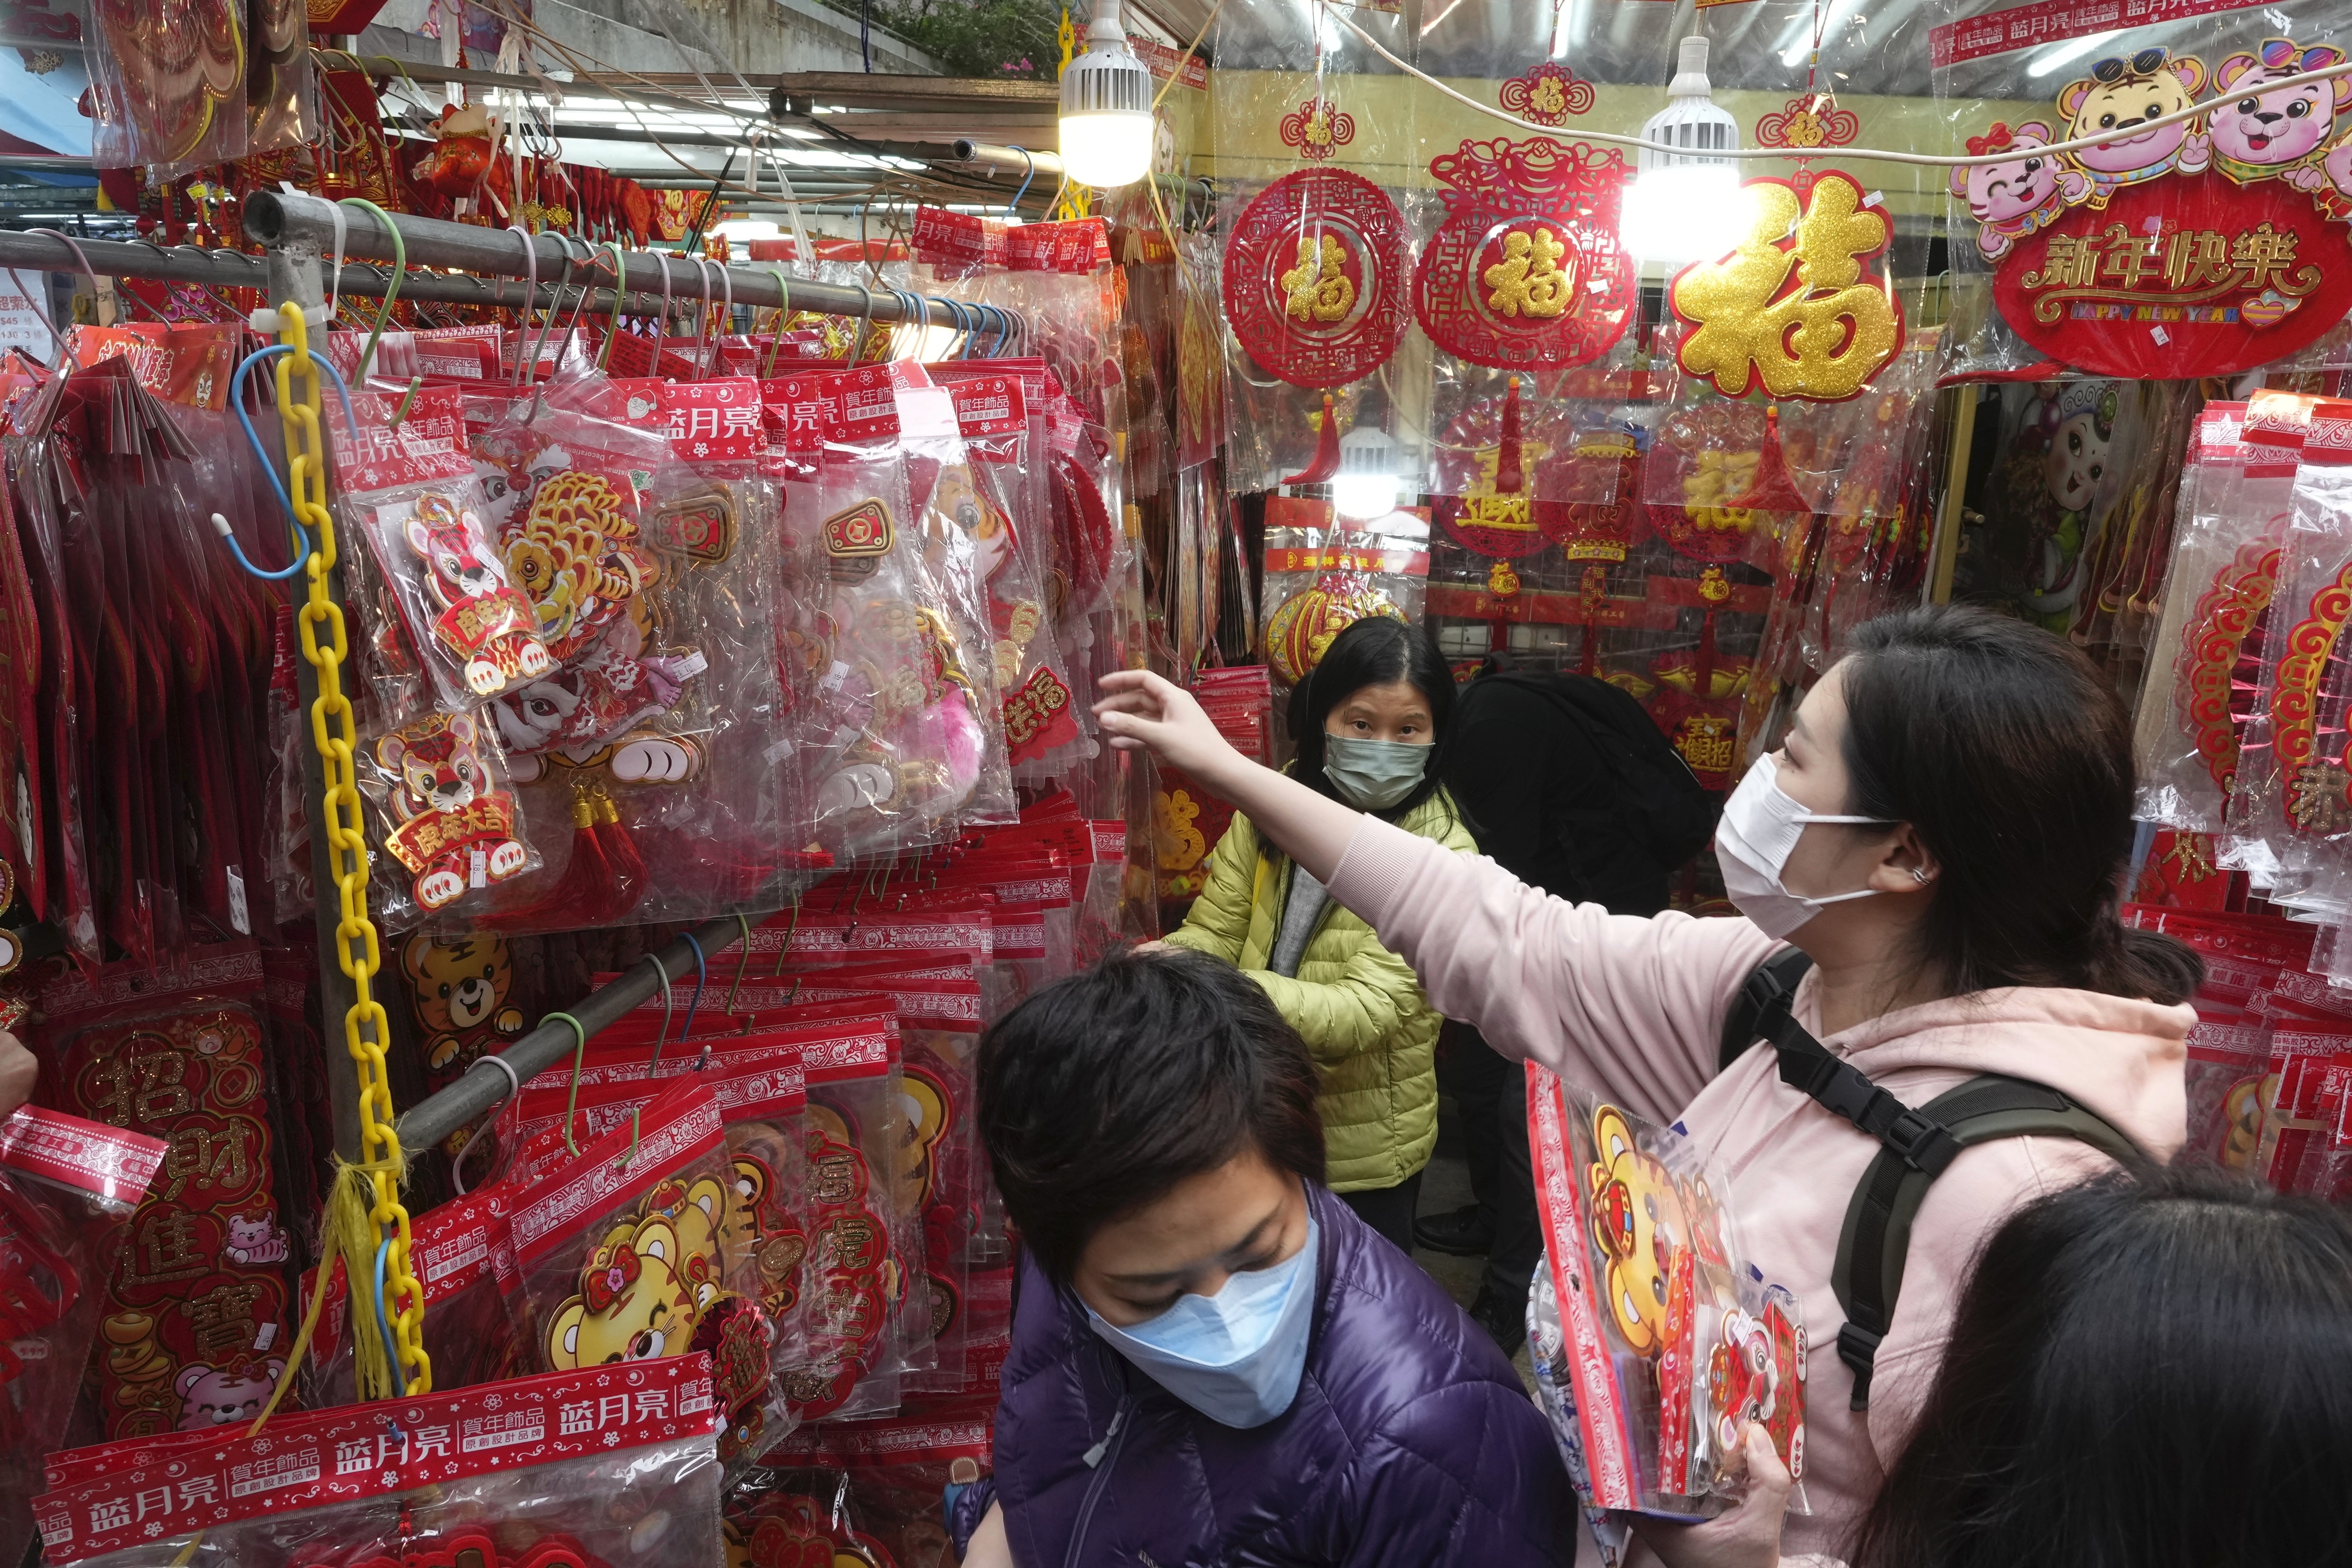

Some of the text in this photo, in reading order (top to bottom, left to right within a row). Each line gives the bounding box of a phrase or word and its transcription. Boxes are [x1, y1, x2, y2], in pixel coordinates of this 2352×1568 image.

[2010, 12, 2070, 39] 蓝月亮
[1484, 228, 1573, 318] 福
[2031, 223, 2310, 293] 新年快樂
[1281, 234, 1355, 322] 福
[1675, 176, 1897, 398] 福
[2071, 304, 2239, 323] HAPPY NEW YEAR
[894, 376, 910, 390] 品
[849, 404, 896, 419] 原創設計品
[959, 394, 1009, 412] 賀年飾品
[960, 410, 1008, 421] 原創設計品牌
[658, 406, 753, 440] 蓝月亮
[563, 447, 605, 461] Decorations
[604, 467, 639, 480] Christmas
[414, 804, 504, 858] 虎年大吉
[793, 935, 844, 944] 皇冠賀年飾
[897, 932, 956, 941] 皇冠賀年飾品
[740, 994, 803, 1004] 皇冠賀年品
[896, 1001, 957, 1011] 皇冠賀年飾品
[128, 1161, 154, 1177] 福中
[523, 1189, 582, 1234] 皇冠賀年飾品
[424, 1225, 487, 1268] 賀年飾品
[428, 1245, 486, 1280] 原創設計品牌
[88, 1474, 219, 1534] 蓝月亮
[230, 1447, 320, 1483] 賀年飾品
[334, 1423, 451, 1476] 蓝月亮
[462, 1406, 545, 1436] 賀年飾品
[558, 1388, 669, 1436] 蓝月亮
[234, 1469, 318, 1496] 原創設計品牌
[465, 1429, 542, 1450] 原創設計品牌
